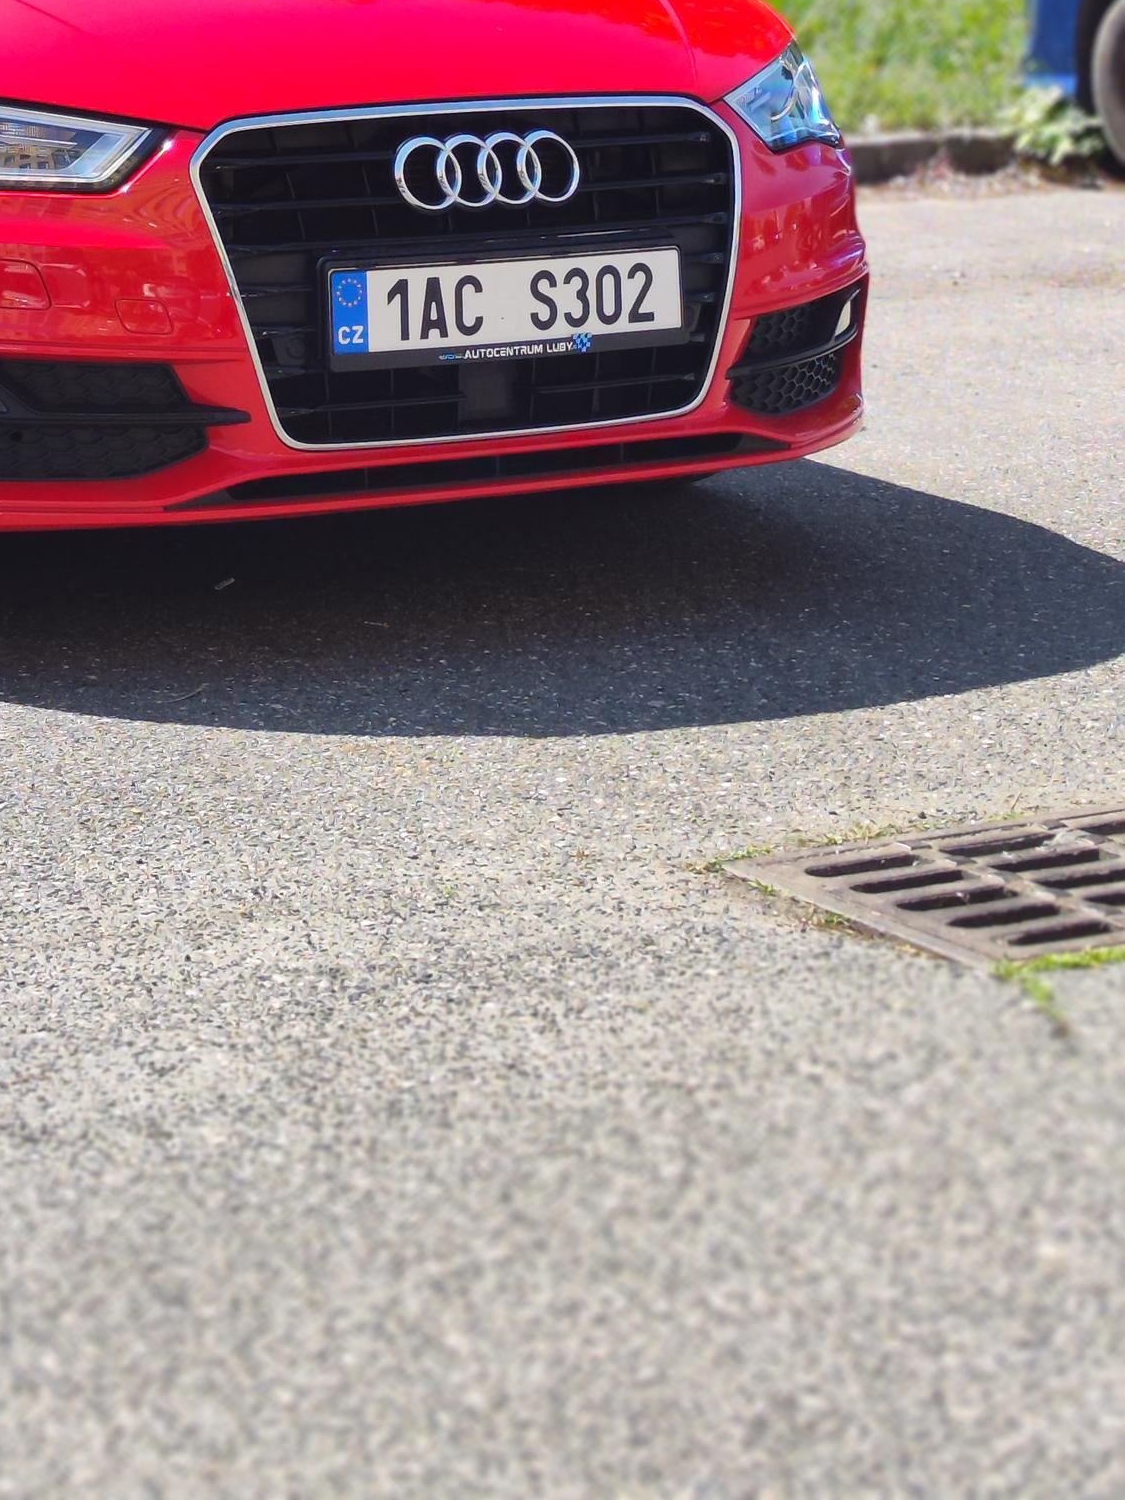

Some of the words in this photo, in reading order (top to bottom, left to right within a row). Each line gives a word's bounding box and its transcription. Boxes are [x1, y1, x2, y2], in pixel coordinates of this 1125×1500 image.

[386, 275, 484, 342] 1AC
[529, 262, 655, 331] S302
[338, 325, 364, 345] CZ
[463, 344, 544, 360] AUTOCENTRUM
[546, 342, 574, 354] LUBY
